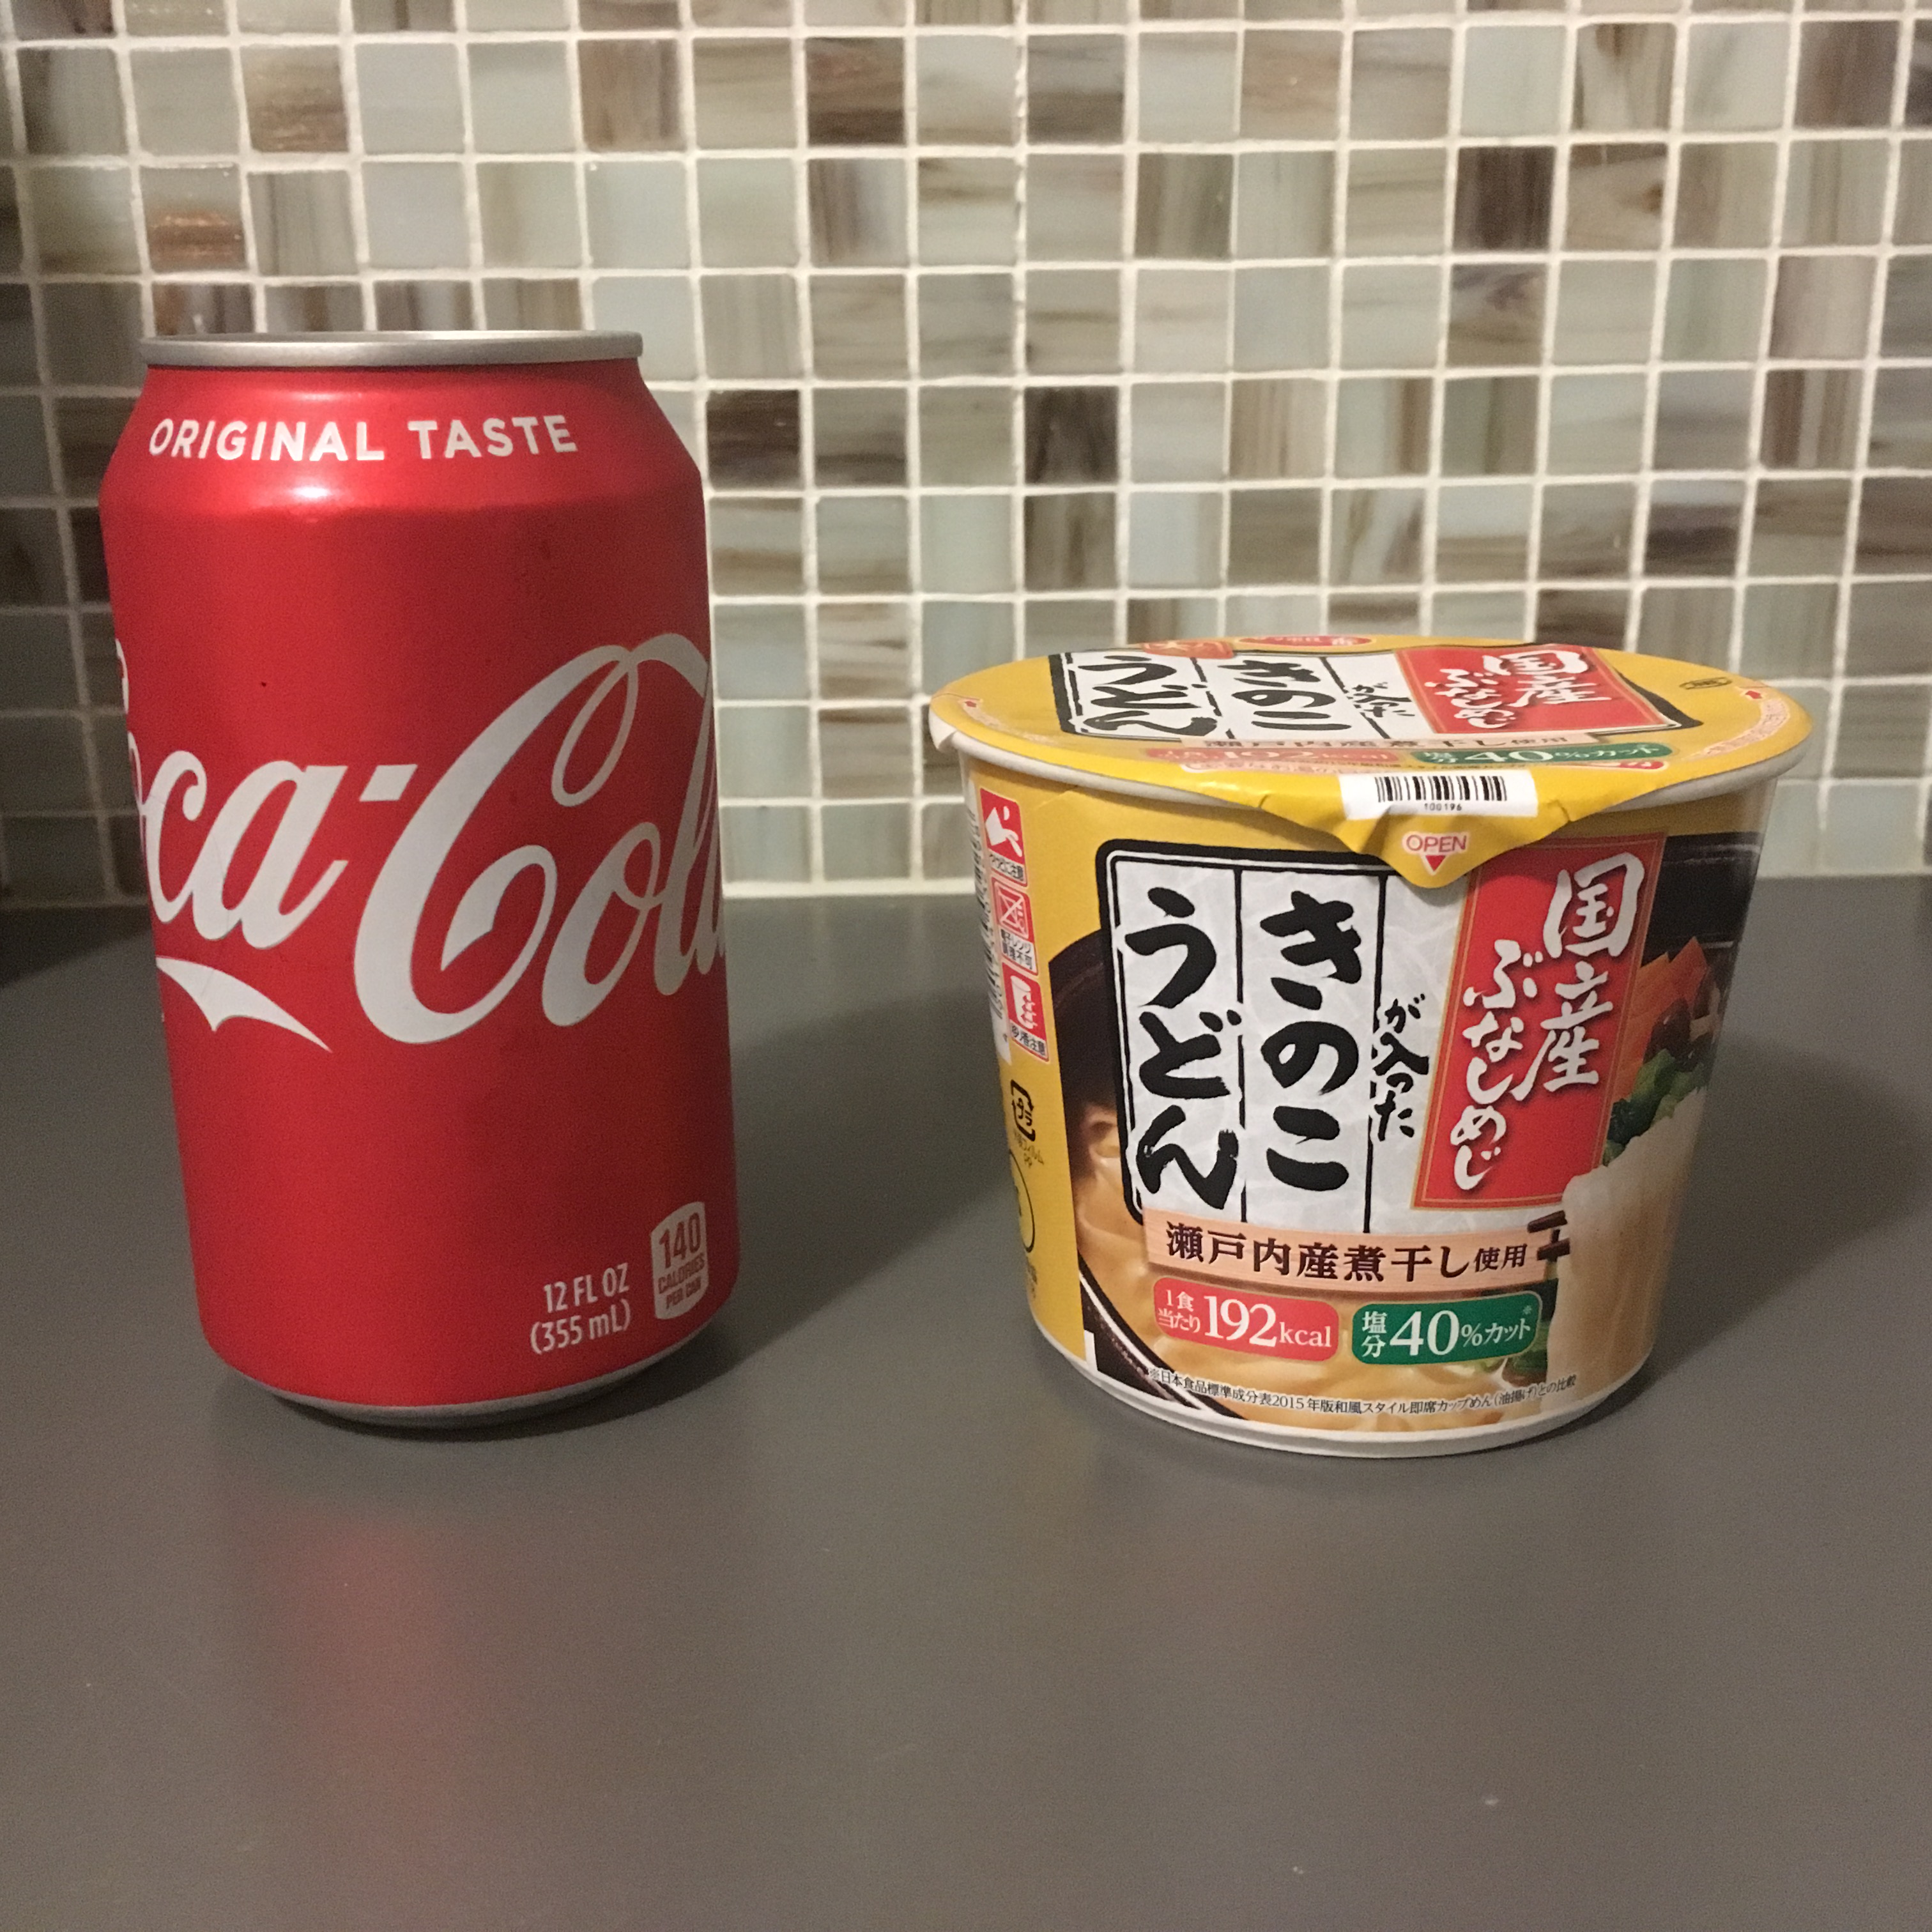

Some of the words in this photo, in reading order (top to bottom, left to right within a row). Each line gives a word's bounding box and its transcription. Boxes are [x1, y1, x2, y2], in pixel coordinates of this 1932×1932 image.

[149, 419, 385, 461] ORIGINAL
[408, 414, 578, 458] TASTE
[1078, 654, 1218, 737] うどん
[1218, 659, 1351, 731] きのこ
[1424, 802, 1462, 811] 100196
[1406, 834, 1467, 853] OPEN
[1510, 852, 1645, 1101] 国産
[1124, 887, 1242, 1210] うどん
[1260, 891, 1362, 1192] きのこ
[1374, 993, 1429, 1142] が入った
[1450, 939, 1544, 1190] ぶなしめじ
[659, 1213, 702, 1269] 140
[1166, 1220, 1528, 1282] 瀬戸内産煮干し使用
[544, 1281, 569, 1313] 12
[574, 1274, 598, 1307] FL
[602, 1262, 630, 1298] OZ
[658, 1252, 705, 1294] CALORIES
[666, 1287, 683, 1310] PER
[686, 1276, 702, 1298] CAN
[1165, 1289, 1194, 1312] 1食
[530, 1315, 583, 1355] (355
[588, 1298, 631, 1340] mL)
[1158, 1308, 1201, 1333] 当たり
[1361, 1310, 1387, 1358] 塩分
